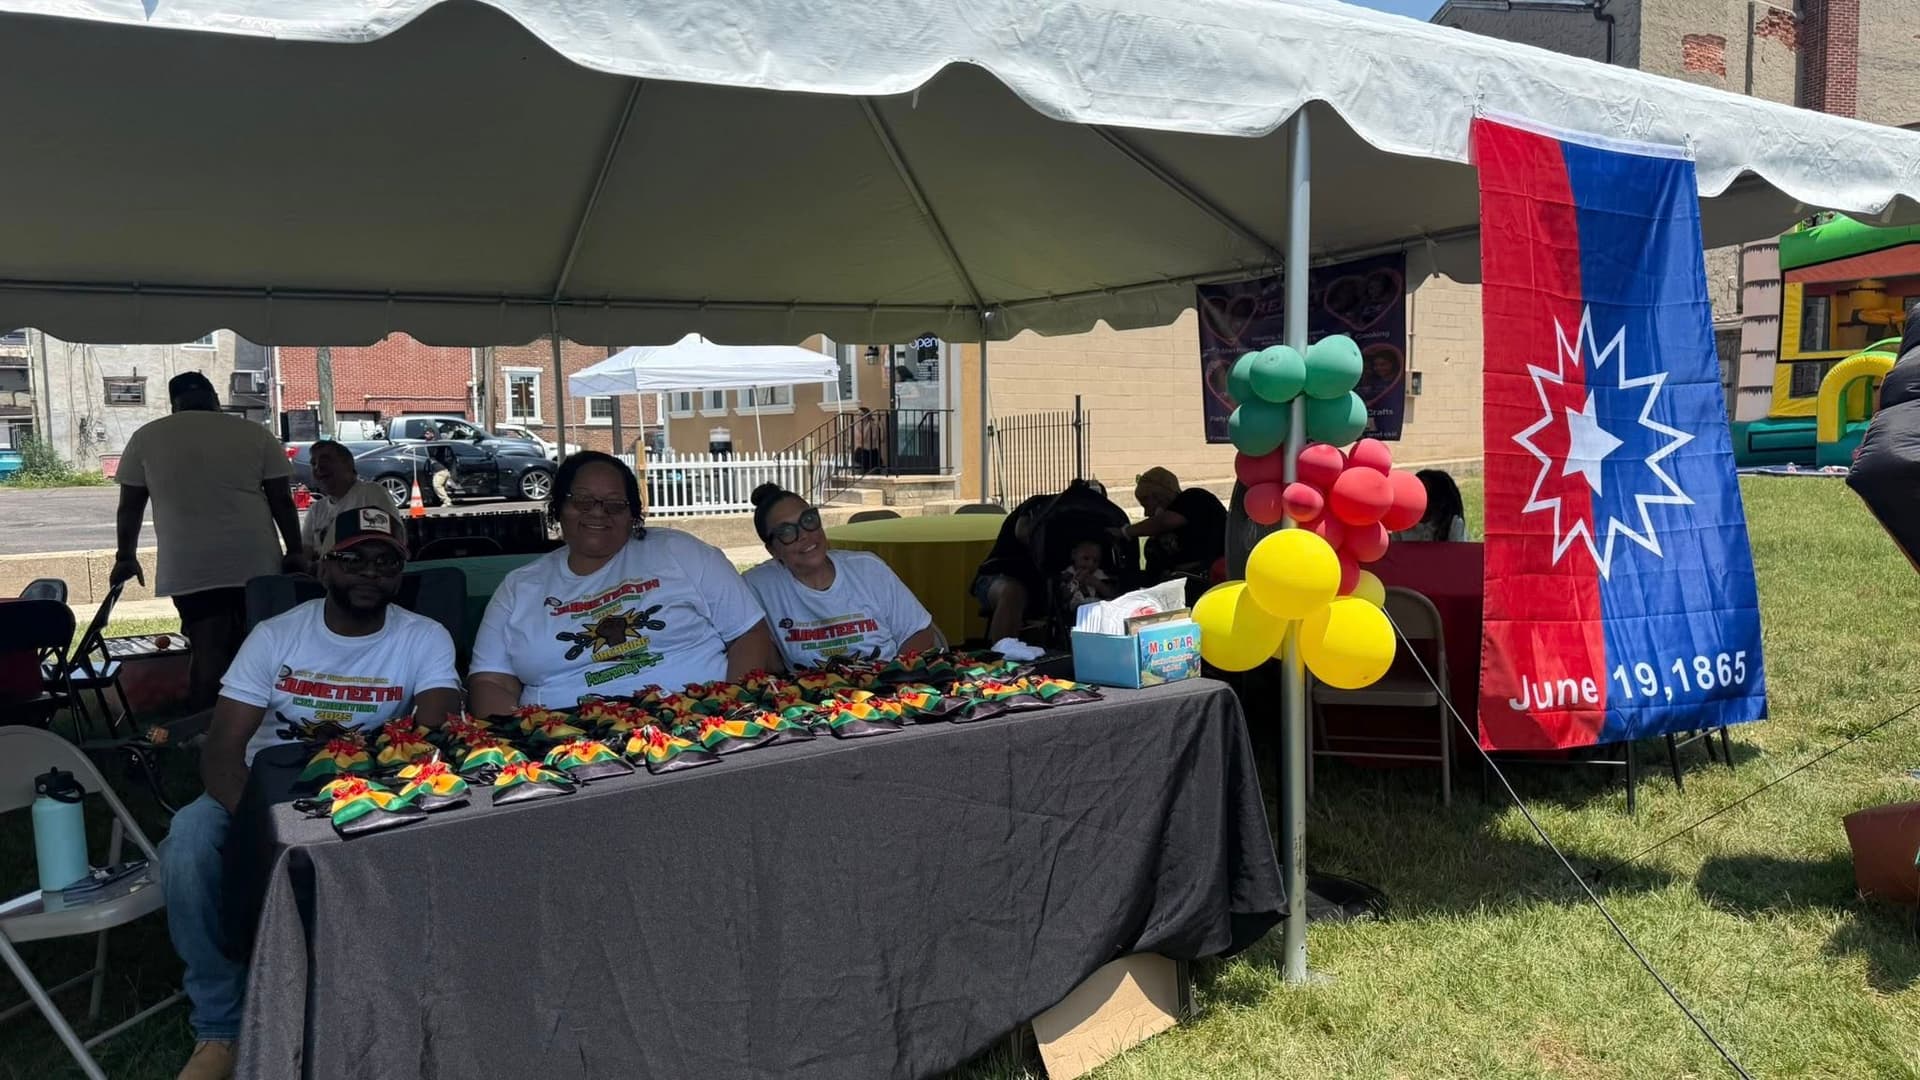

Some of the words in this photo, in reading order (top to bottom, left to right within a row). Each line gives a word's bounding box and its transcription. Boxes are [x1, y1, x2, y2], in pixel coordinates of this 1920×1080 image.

[550, 578, 660, 616] JUNETEETH
[785, 618, 878, 642] JUNETEETH
[275, 677, 403, 702] JUNETEETH
[1509, 674, 1599, 710] June
[1613, 651, 1746, 701] 19,1865
[314, 710, 352, 721] 2025
